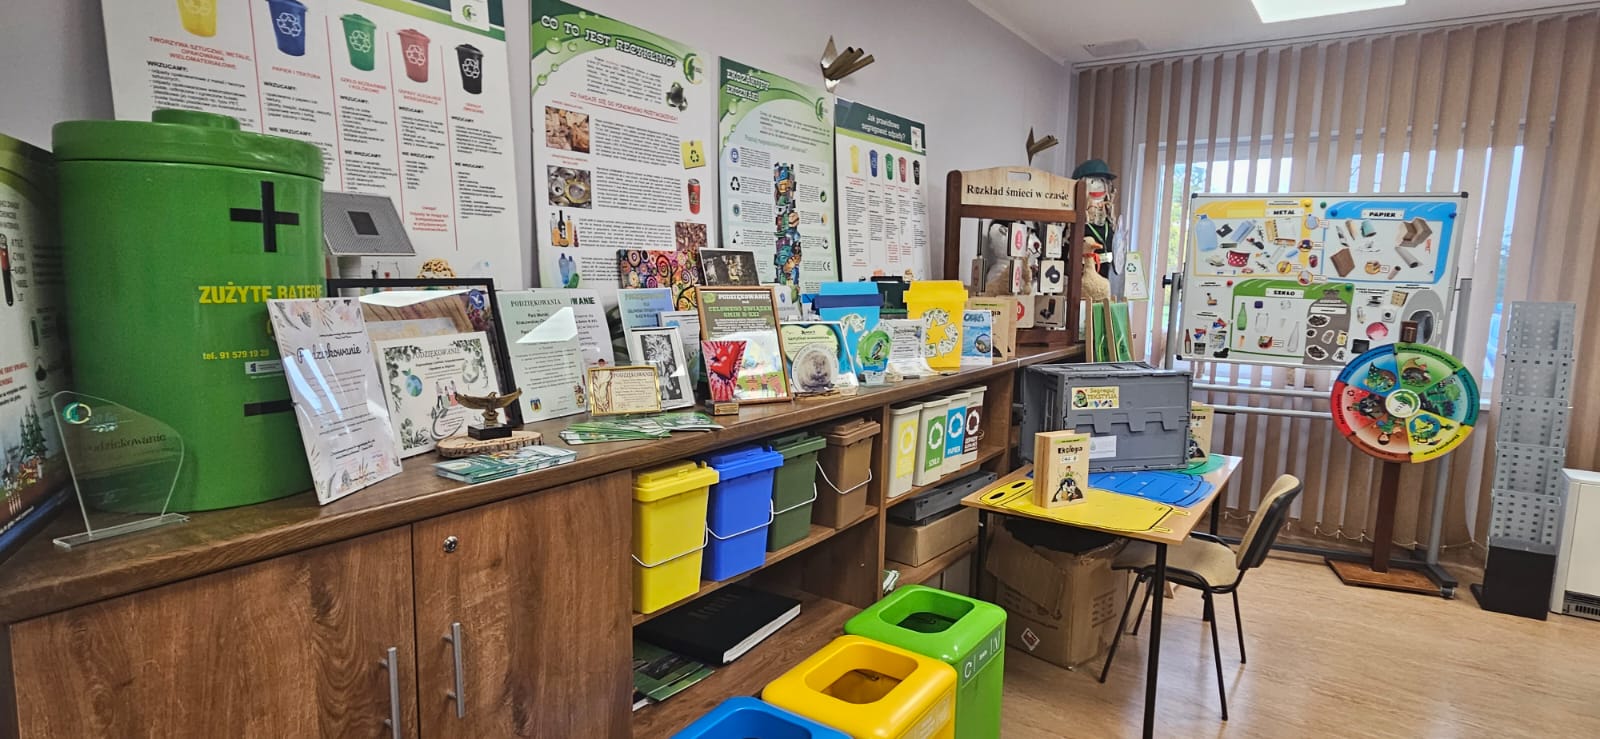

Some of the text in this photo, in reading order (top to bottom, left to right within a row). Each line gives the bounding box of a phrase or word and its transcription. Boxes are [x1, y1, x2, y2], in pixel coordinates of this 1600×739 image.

[541, 16, 558, 30] CO
[564, 22, 580, 36] TO
[584, 30, 611, 46] JEST
[967, 184, 1004, 196] Rozkład
[1006, 187, 1033, 198] śmieci
[1045, 190, 1069, 200] czasie
[198, 282, 272, 304] ZUŻYTE
[202, 352, 218, 360] tel.
[220, 352, 230, 360] 91
[1058, 445, 1083, 454] Ekologia
